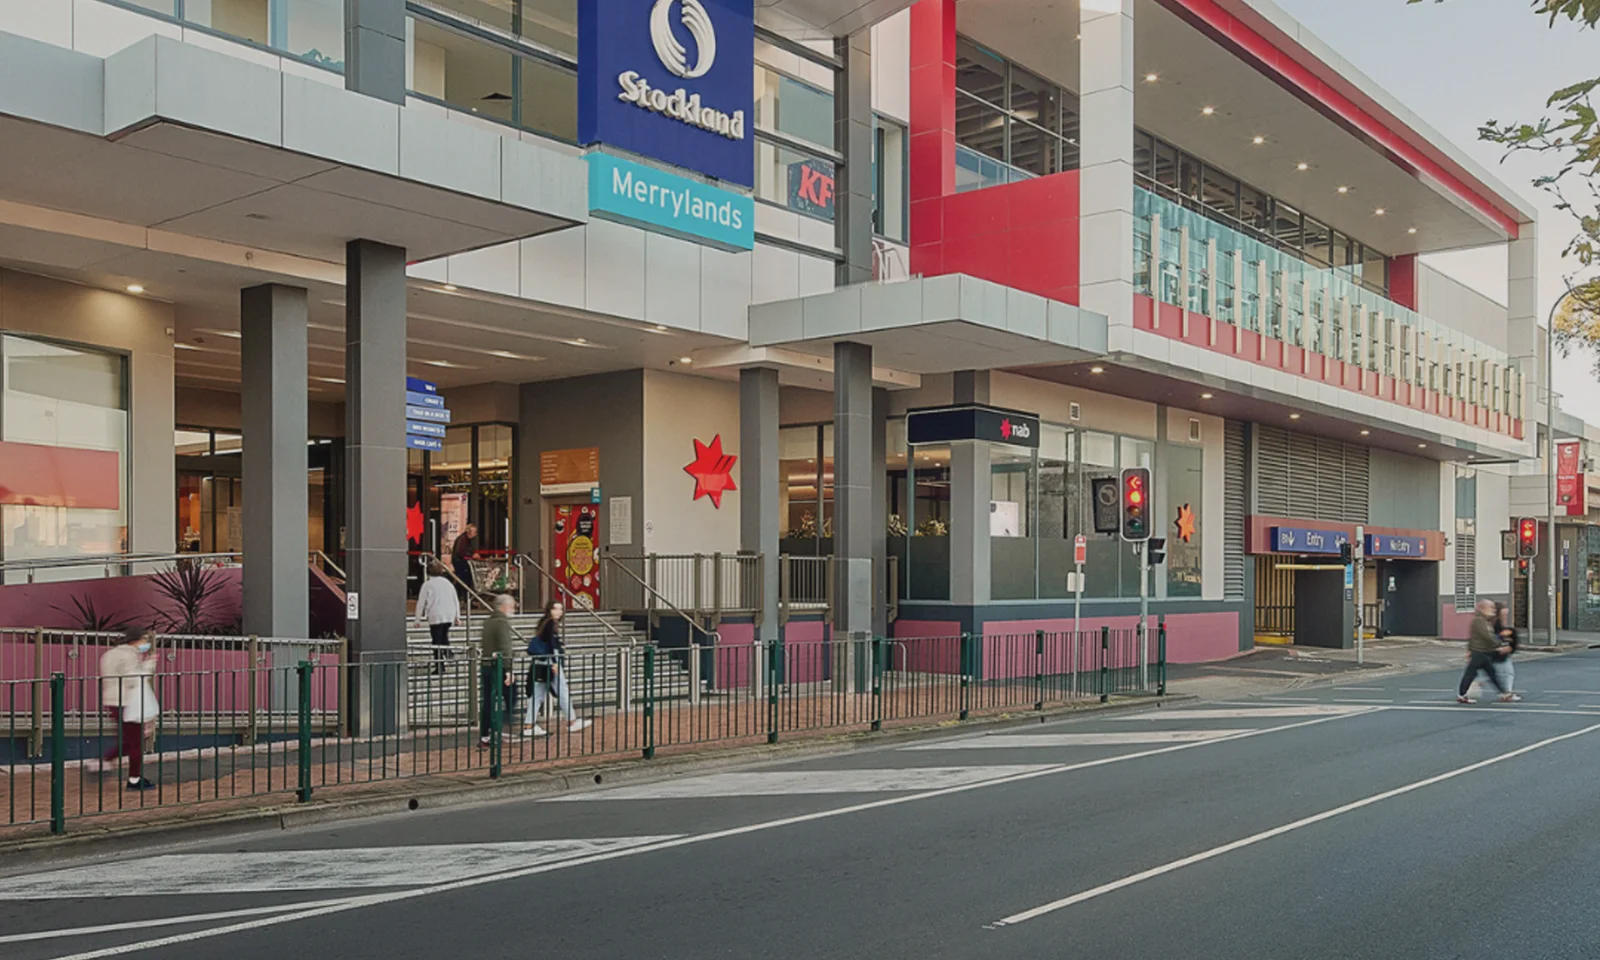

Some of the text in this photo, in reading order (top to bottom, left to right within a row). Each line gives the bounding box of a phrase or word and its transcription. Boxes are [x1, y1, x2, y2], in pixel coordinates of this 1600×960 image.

[617, 70, 745, 140] Stockland
[612, 167, 743, 230] Merrylands
[798, 165, 835, 208] KF
[1012, 423, 1030, 438] nab
[1306, 531, 1324, 549] Entry
